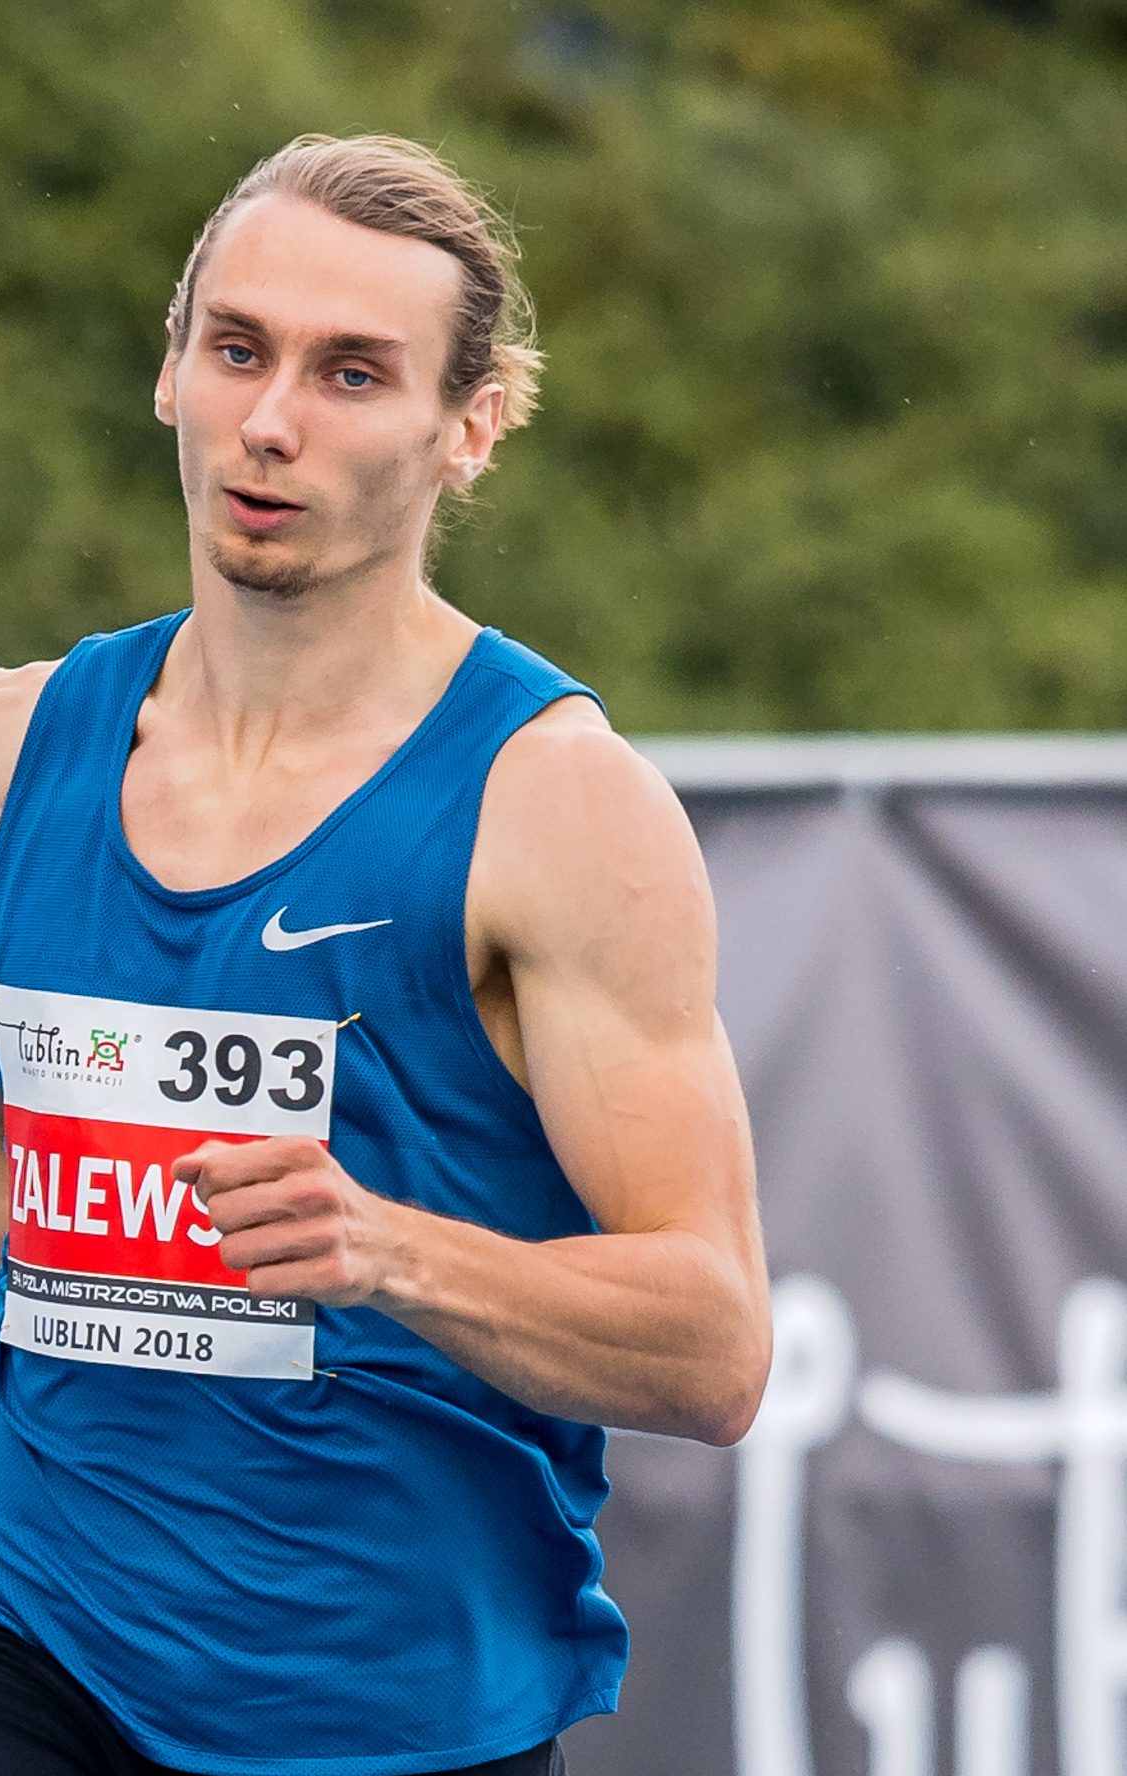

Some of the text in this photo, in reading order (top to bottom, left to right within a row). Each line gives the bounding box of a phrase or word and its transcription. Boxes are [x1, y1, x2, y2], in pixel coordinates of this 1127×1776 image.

[51, 1070, 123, 1087] INSPIRACJI
[158, 1030, 326, 1112] 393
[50, 1279, 207, 1312] MISTRZOSTWA
[212, 1295, 298, 1319] POLSKI
[33, 1314, 215, 1362] LUBLIN 2018
